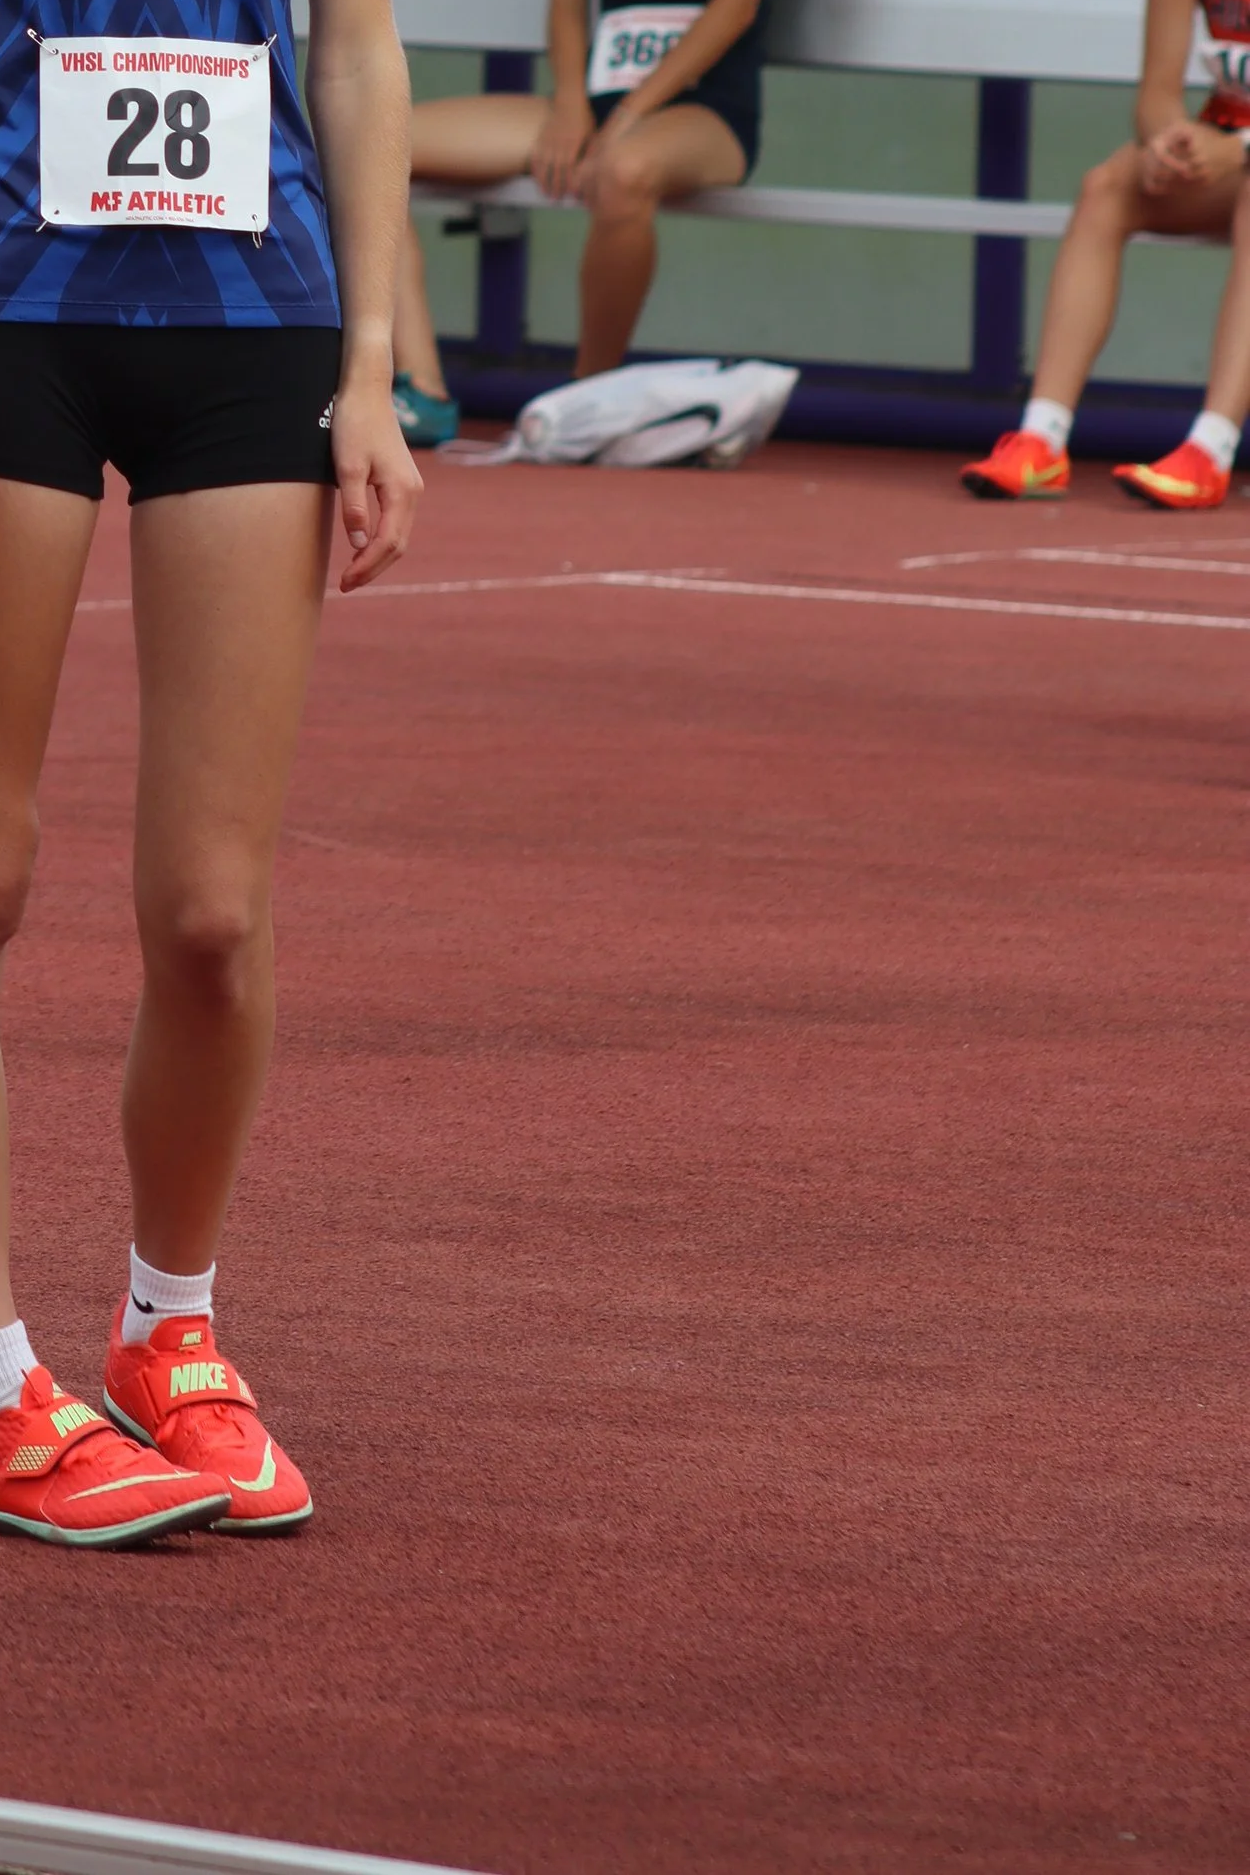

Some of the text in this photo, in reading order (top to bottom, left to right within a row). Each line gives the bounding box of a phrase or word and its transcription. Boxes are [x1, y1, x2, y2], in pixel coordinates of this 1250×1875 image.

[61, 51, 250, 79] VHSL CHAMPIONSHIPS
[106, 87, 211, 181] 28
[127, 190, 226, 216] ATHLETIC
[181, 1330, 203, 1346] NIKE
[170, 1361, 229, 1399] NIKE
